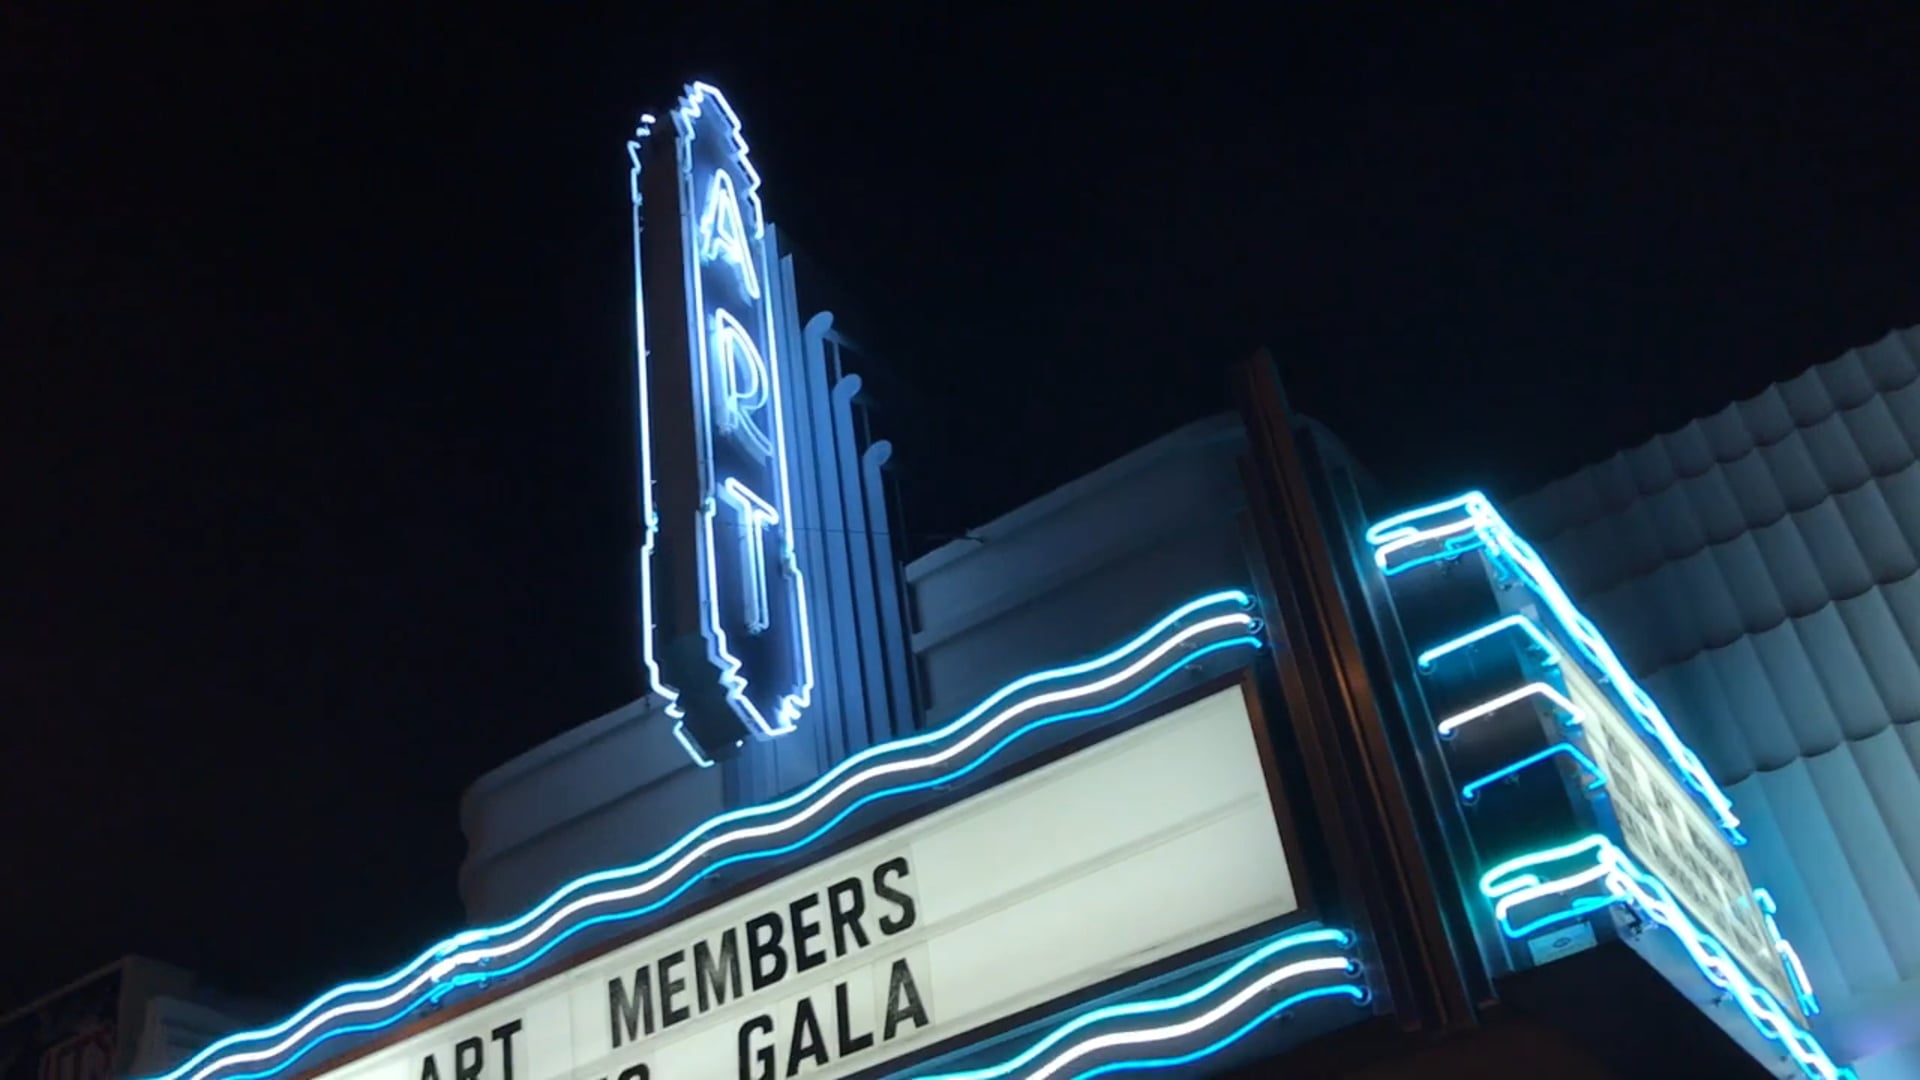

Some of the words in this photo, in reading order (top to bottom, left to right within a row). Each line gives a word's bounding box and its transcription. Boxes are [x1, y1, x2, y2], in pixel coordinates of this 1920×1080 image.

[700, 169, 778, 633] ART
[608, 857, 916, 1049] MEMBERS
[737, 958, 929, 1080] GALA
